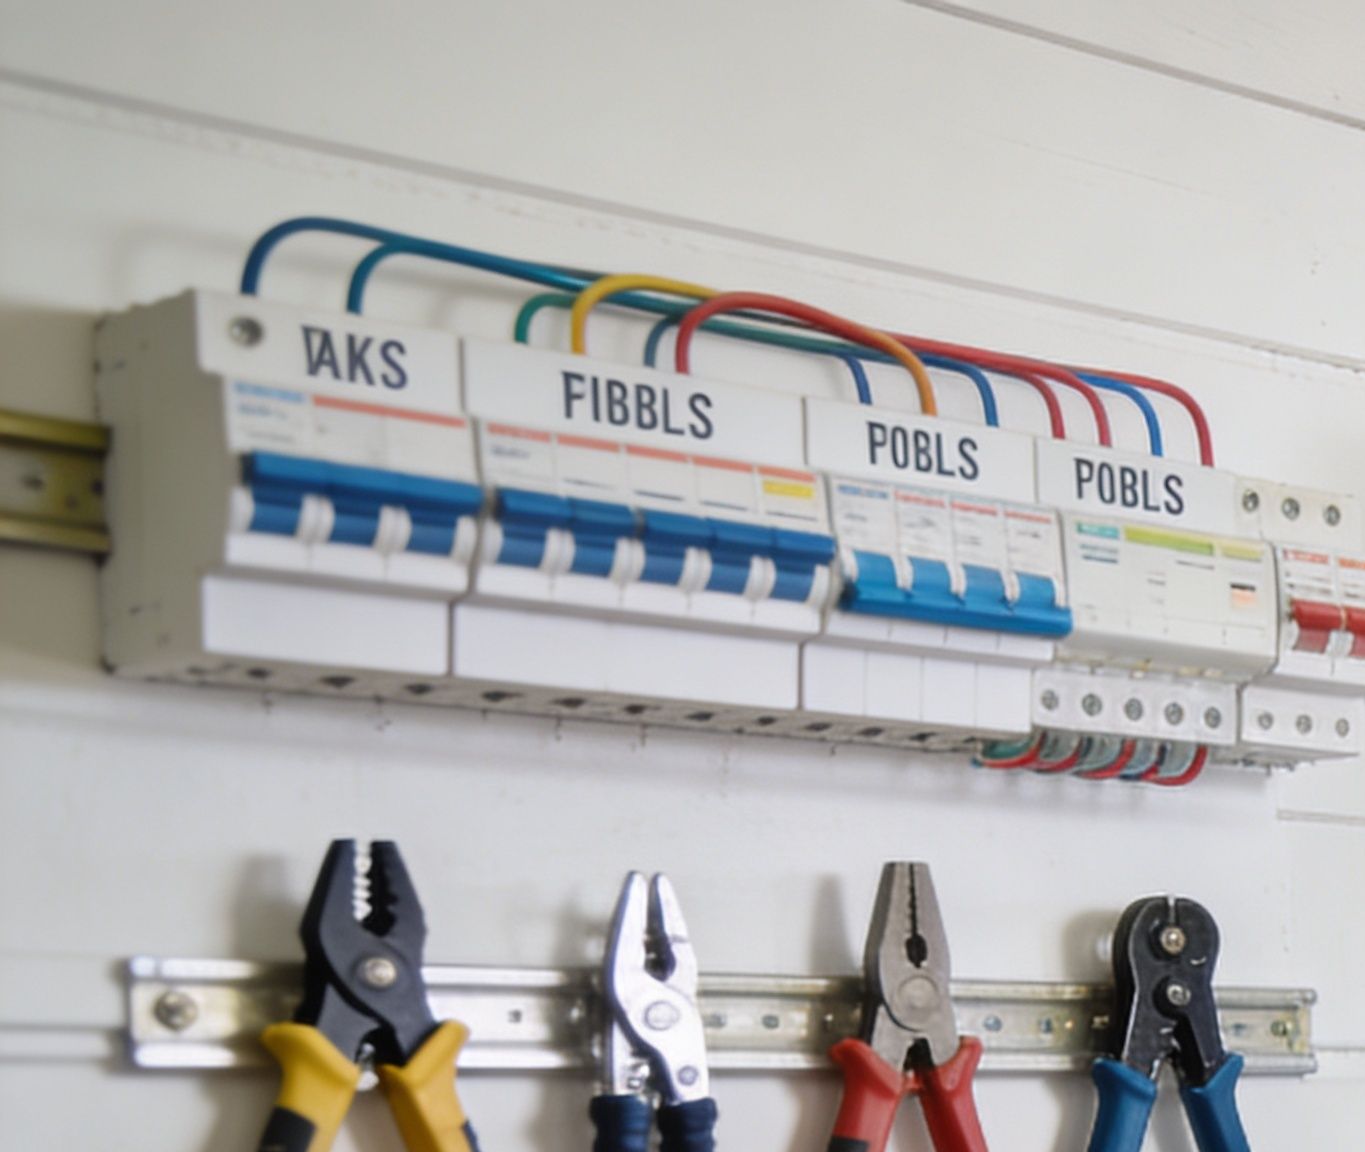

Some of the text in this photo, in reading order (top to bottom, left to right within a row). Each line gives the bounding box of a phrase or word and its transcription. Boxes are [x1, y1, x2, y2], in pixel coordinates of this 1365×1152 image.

[561, 371, 714, 440] FIBBLS
[867, 421, 980, 480] POBLS
[1074, 457, 1185, 516] POBLS
